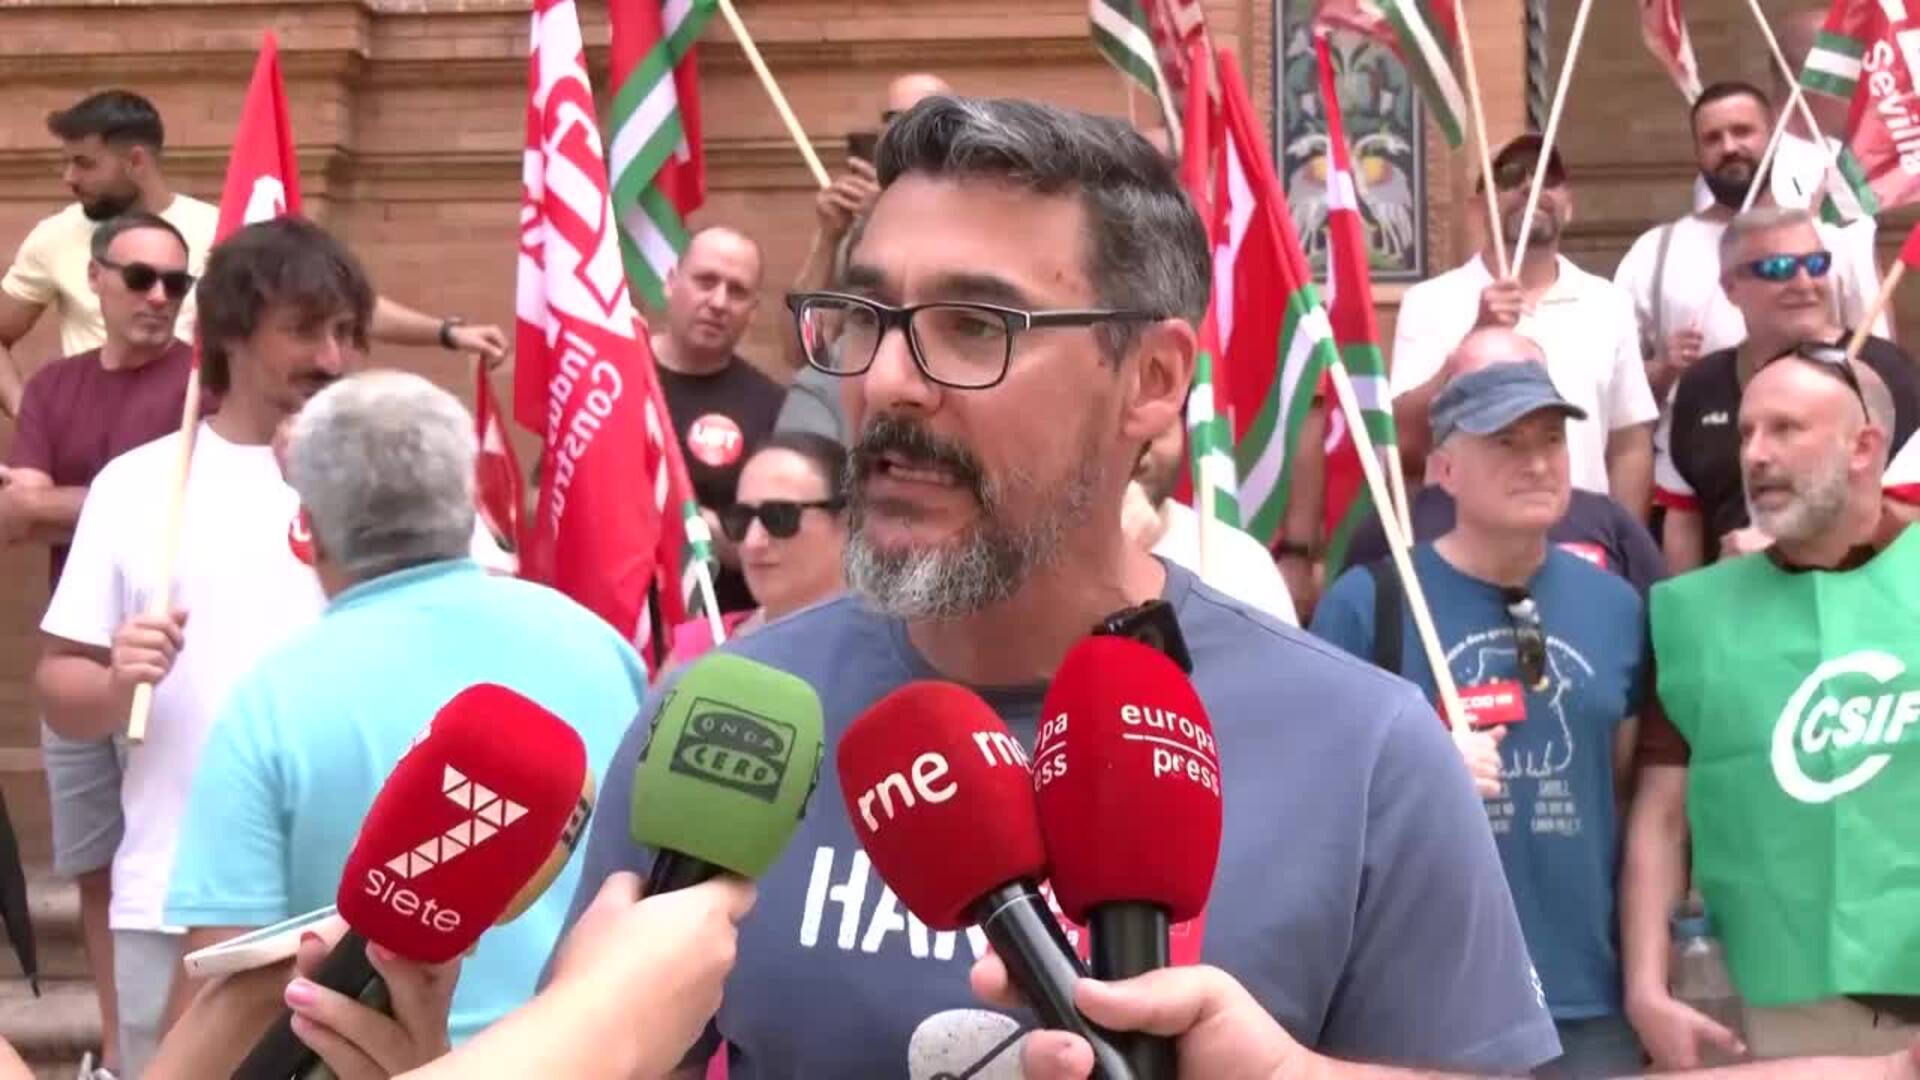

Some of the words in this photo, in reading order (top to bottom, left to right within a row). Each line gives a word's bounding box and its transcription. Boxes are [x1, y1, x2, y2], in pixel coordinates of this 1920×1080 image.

[1864, 38, 1920, 176] Sevilla
[701, 717, 777, 750] ONDA
[1121, 704, 1216, 756] europa
[1801, 690, 1920, 753] CSIF
[693, 746, 769, 782] CERO
[858, 752, 958, 832] rne
[1154, 748, 1219, 797] press
[365, 868, 462, 933] siete
